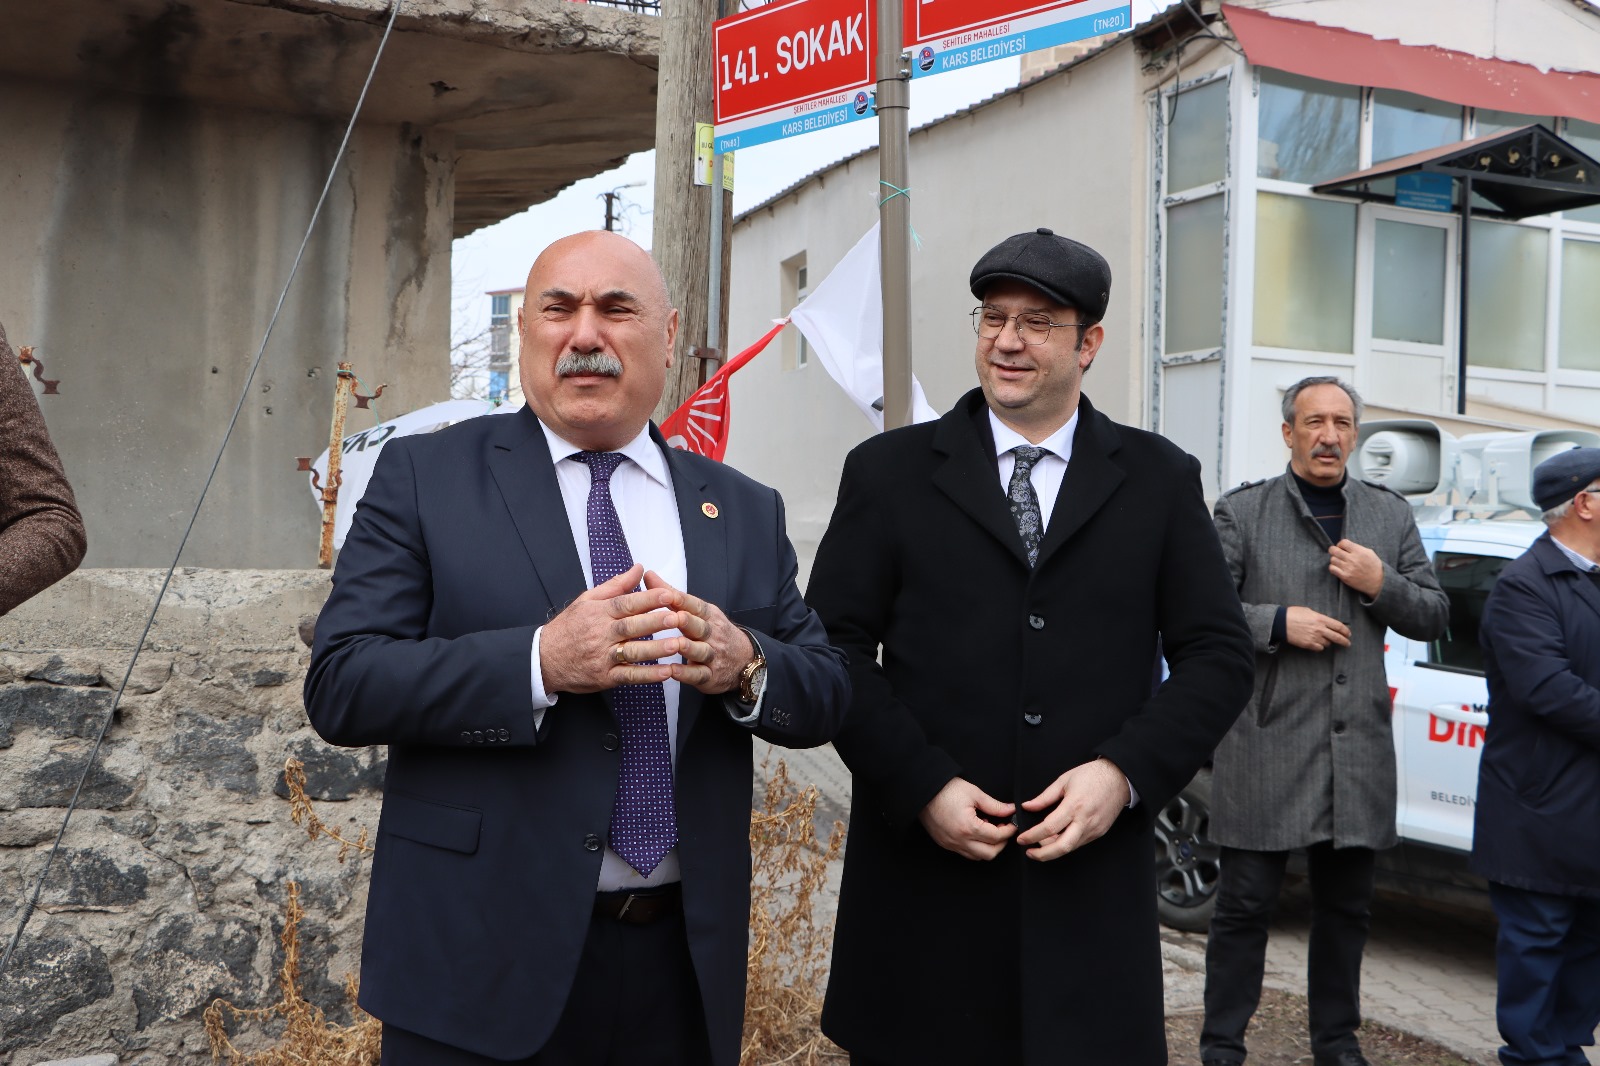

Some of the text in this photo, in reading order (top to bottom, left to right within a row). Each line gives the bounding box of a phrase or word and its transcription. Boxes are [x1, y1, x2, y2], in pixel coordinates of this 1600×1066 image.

[721, 12, 863, 91] 141. SOKAK
[943, 24, 1010, 50] ŞEHİTLER MAHALLESİ
[943, 34, 1026, 69] KARS BELEDİYESİ
[793, 93, 848, 115] ŞEHİTLER MAHALLESİ
[782, 107, 848, 136] KARS BELEDİYESİ
